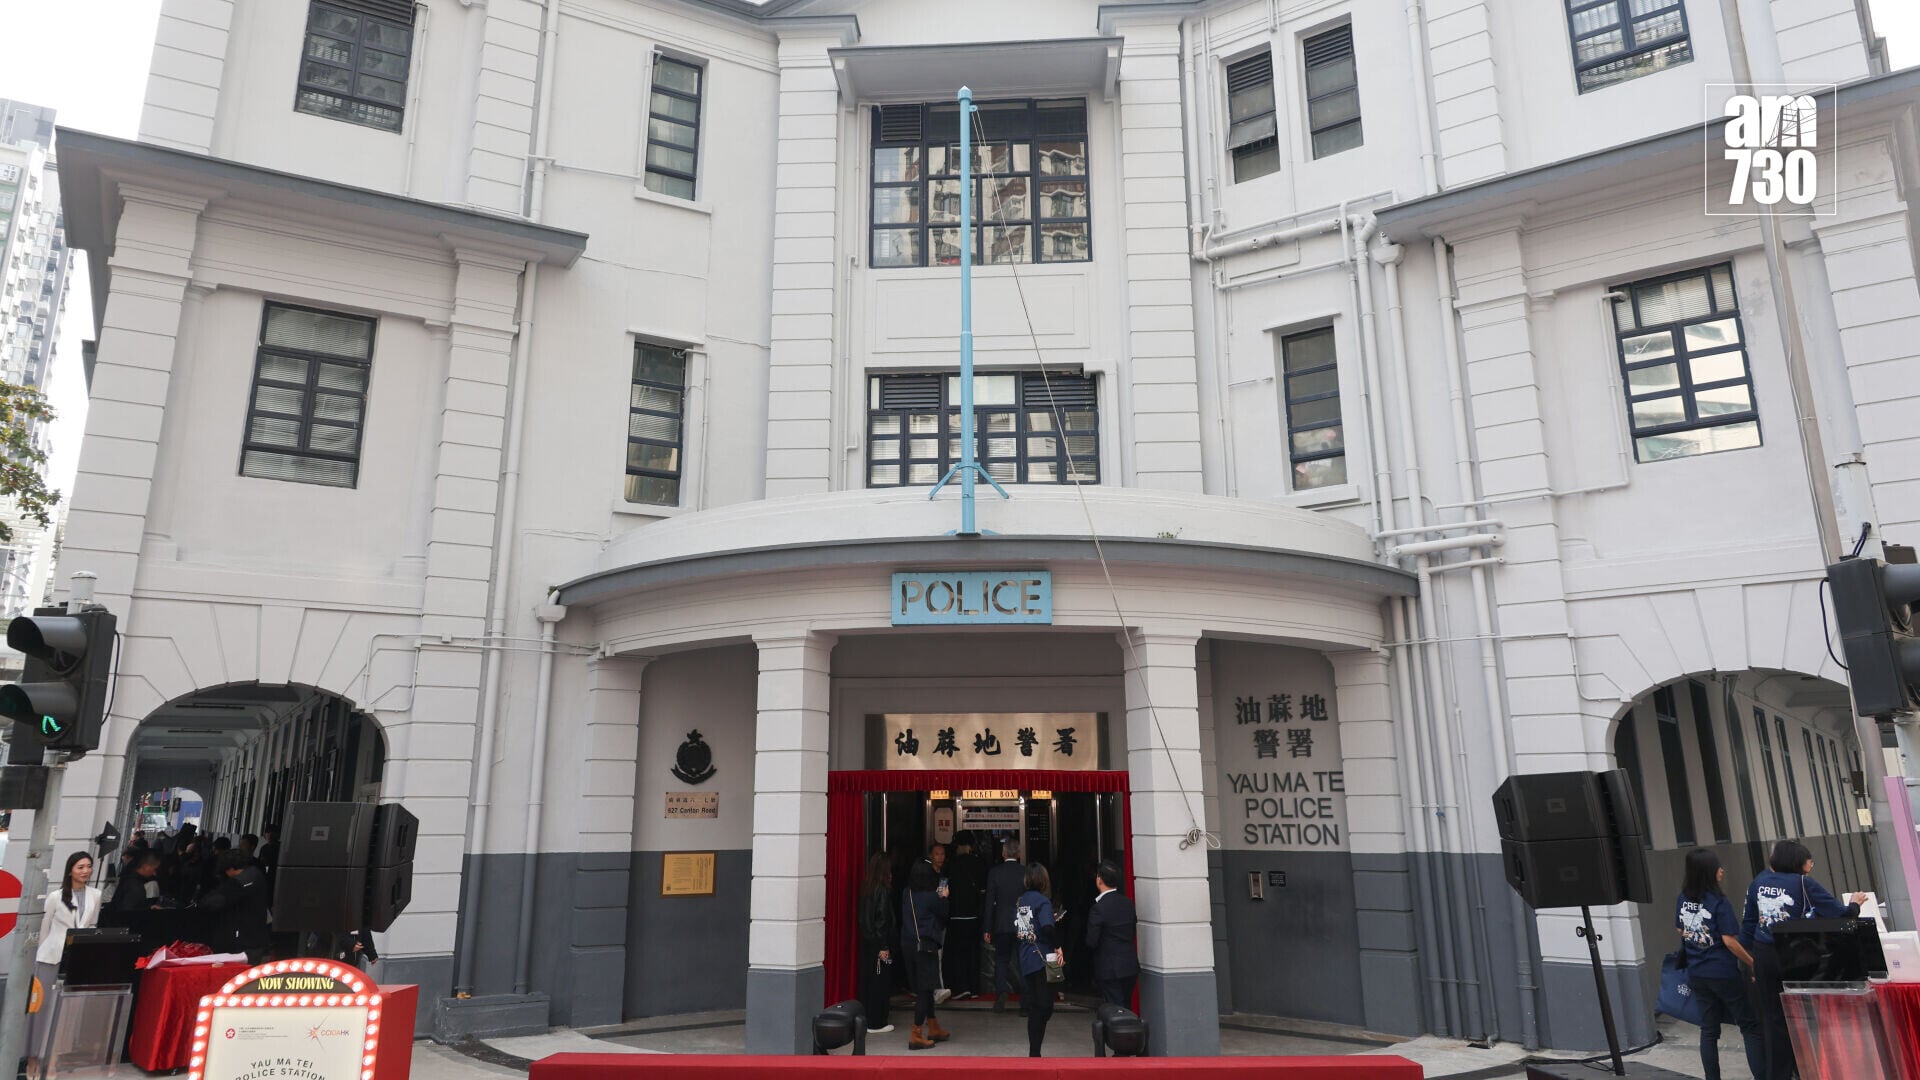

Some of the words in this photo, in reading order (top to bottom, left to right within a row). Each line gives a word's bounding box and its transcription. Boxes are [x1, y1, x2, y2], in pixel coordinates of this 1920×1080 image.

[901, 579, 1042, 615] POLICE
[1234, 693, 1329, 724] 油蔴地
[1252, 728, 1314, 759] 警署
[1226, 772, 1269, 794] YAU
[1273, 771, 1310, 793] MA
[1312, 771, 1345, 793] TE
[966, 790, 993, 798] TICKET
[1000, 790, 1015, 798] BOX
[1245, 797, 1334, 819] POLICE
[1244, 823, 1340, 845] STATION
[1758, 885, 1786, 897] CREW
[257, 977, 284, 990] NOW
[285, 977, 335, 990] SHOWING
[251, 1058, 272, 1069] YAU
[276, 1058, 291, 1066] MA
[296, 1059, 314, 1069] TEI
